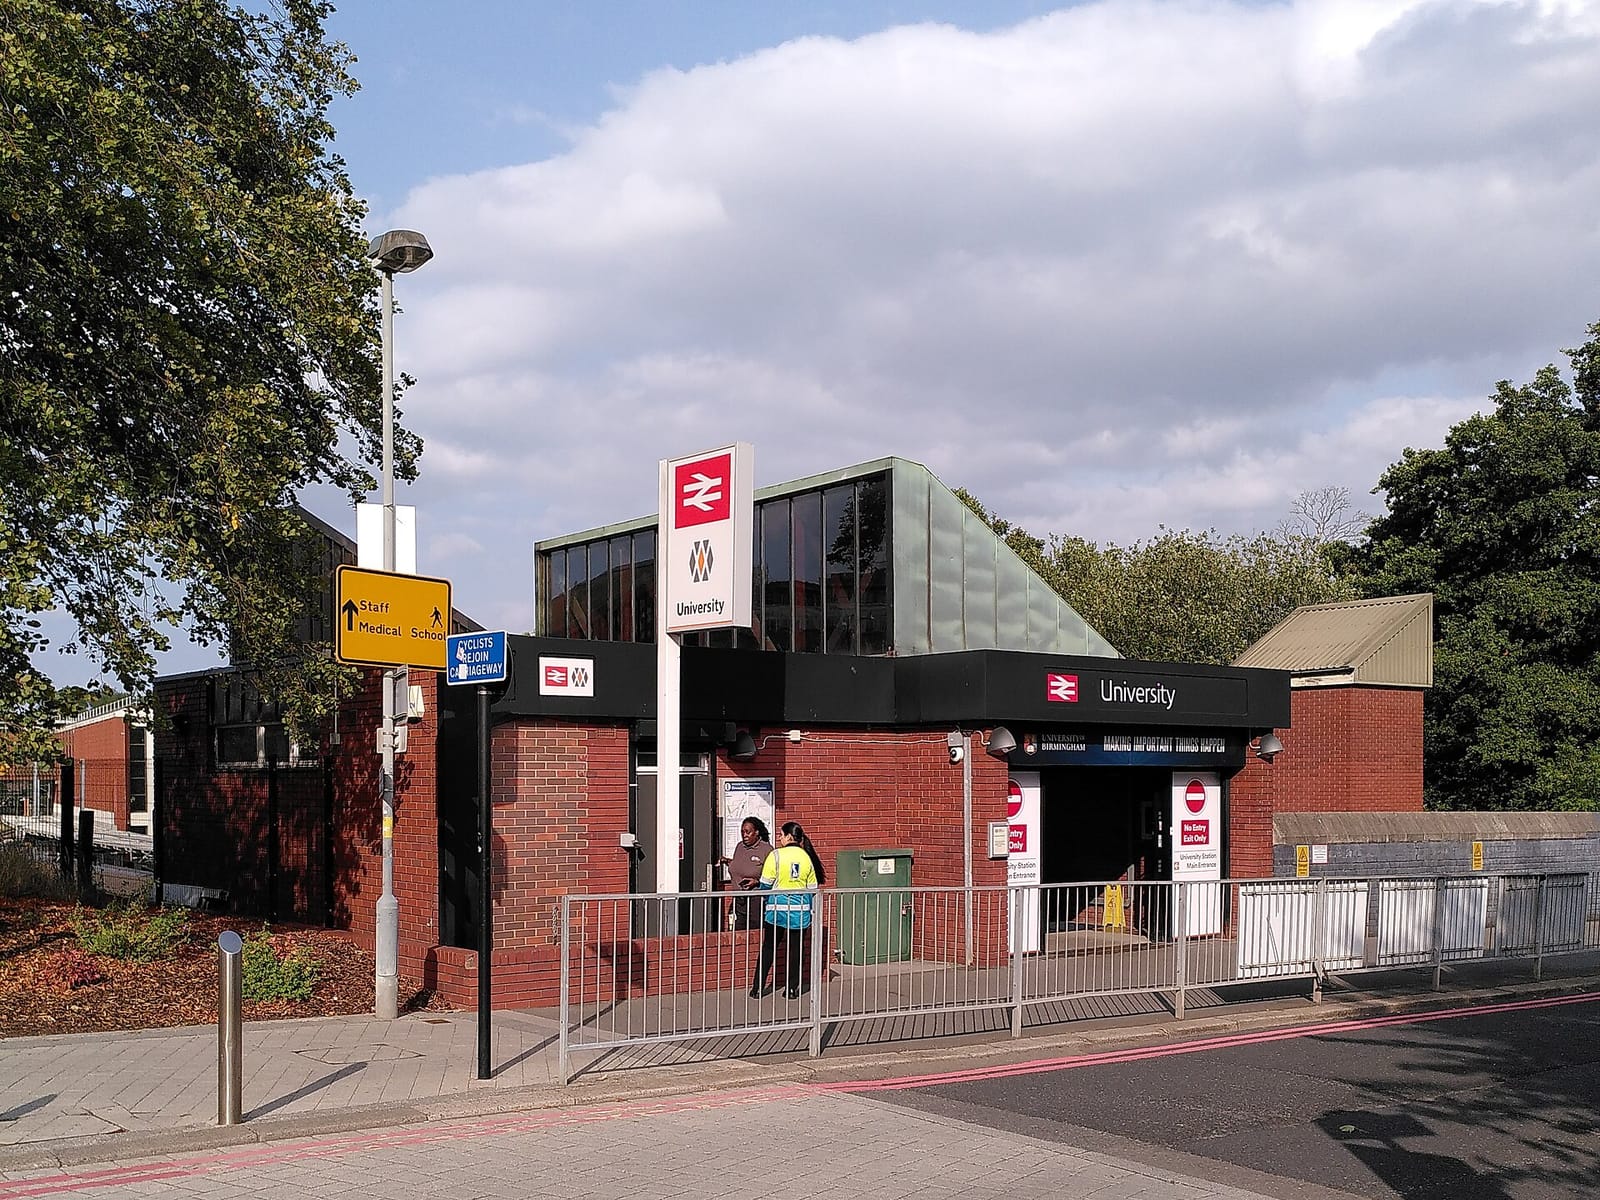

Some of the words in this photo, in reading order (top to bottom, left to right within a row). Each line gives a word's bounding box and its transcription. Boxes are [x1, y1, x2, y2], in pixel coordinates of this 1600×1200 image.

[359, 599, 390, 613] Staff
[677, 598, 725, 616] University
[359, 621, 402, 637] Medical
[411, 627, 447, 641] School
[458, 636, 494, 650] CYCLISTS
[462, 650, 489, 663] REJOIN
[1100, 679, 1176, 710] University
[1041, 734, 1080, 742] UNIVERSITY
[1041, 742, 1086, 751] BIRMINGHAM
[1103, 735, 1132, 752] MAKING
[1133, 736, 1174, 753] IMPORTANT
[1175, 737, 1199, 753] THINGS
[1200, 738, 1225, 753] HAPPEN
[1183, 824, 1192, 832] No
[1192, 824, 1206, 833] Entry
[1009, 830, 1023, 839] ntry
[1194, 834, 1206, 843] Only
[1009, 841, 1023, 850] Only
[1180, 853, 1201, 861] University
[1017, 861, 1036, 869] Station
